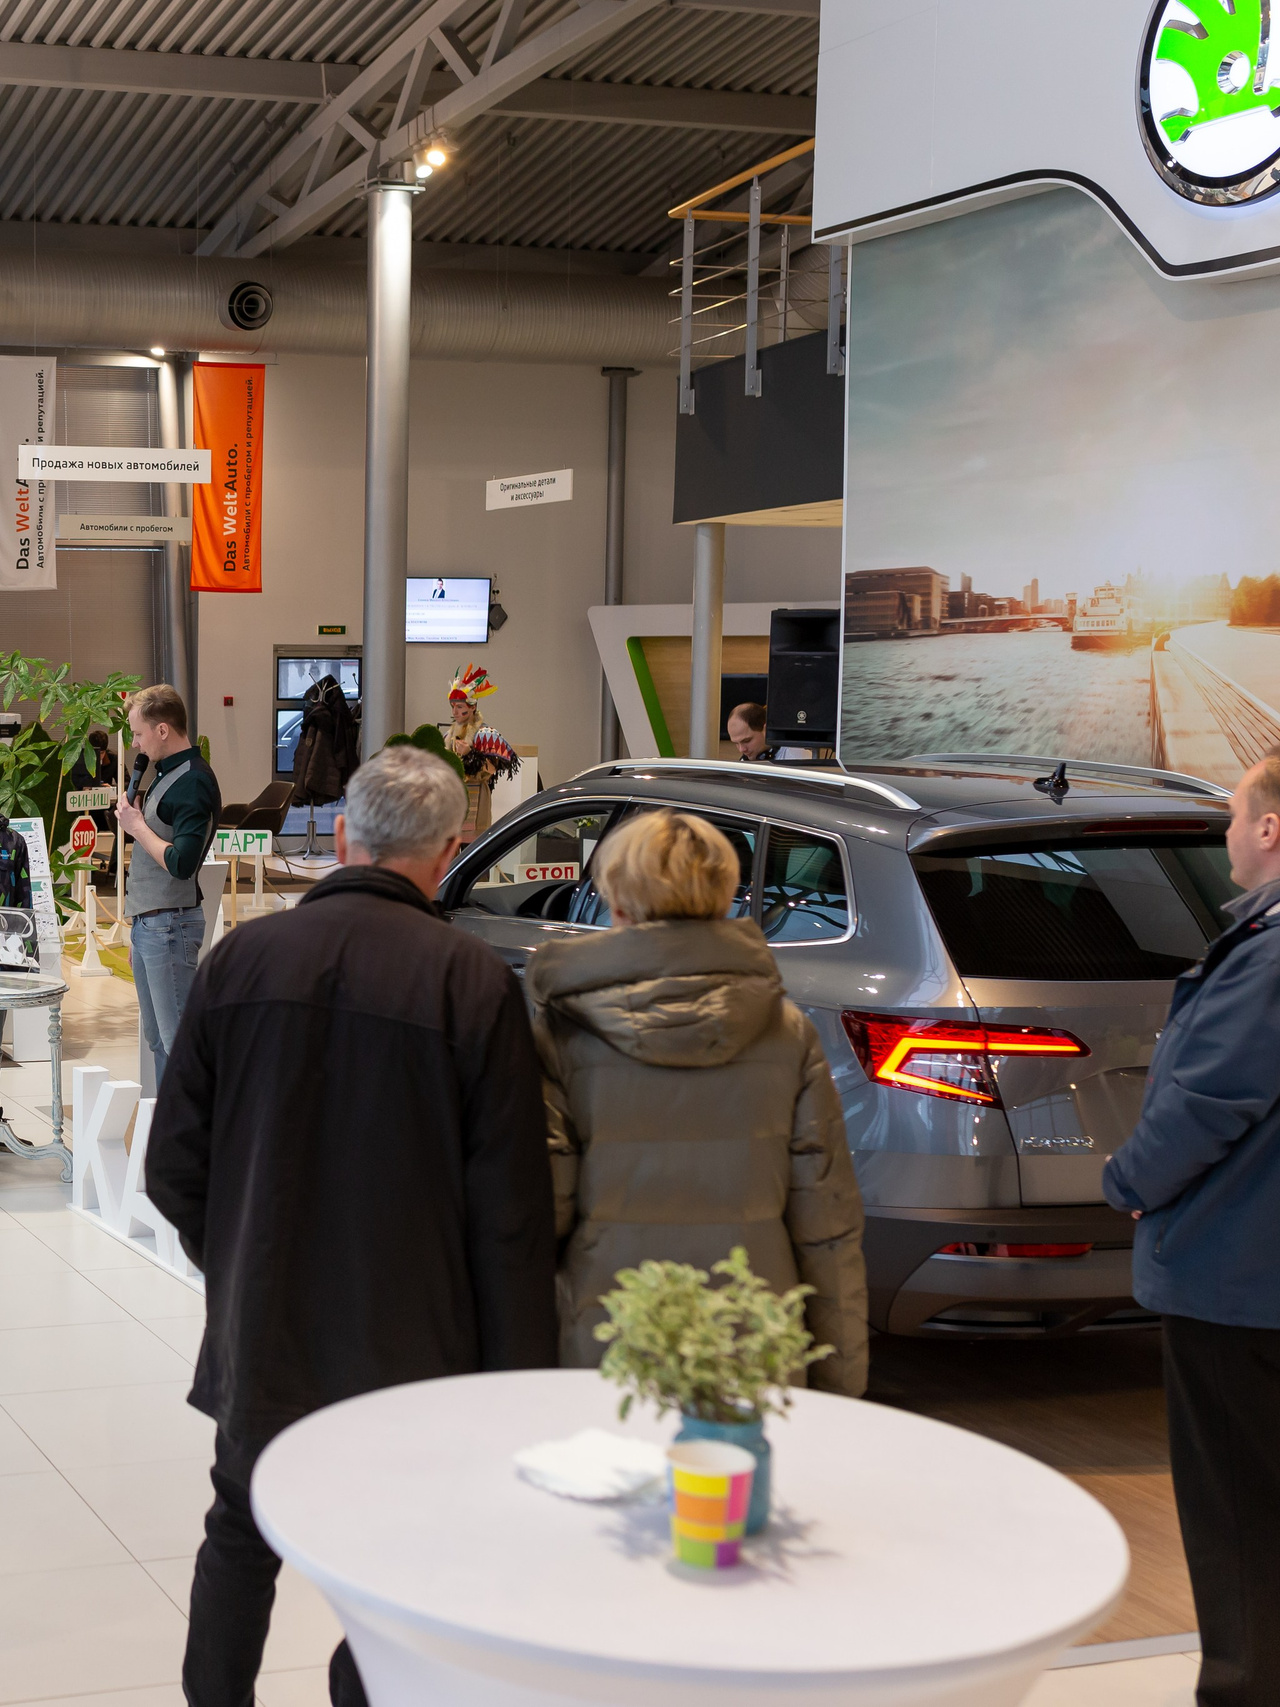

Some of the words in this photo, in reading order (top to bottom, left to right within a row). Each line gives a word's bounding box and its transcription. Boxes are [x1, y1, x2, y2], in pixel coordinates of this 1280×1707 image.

[35, 369, 45, 436] репутацией.
[245, 376, 254, 439] репутацией.
[32, 457, 84, 470] Продажа
[87, 460, 124, 470] новых
[126, 460, 200, 472] автомобилей
[244, 450, 253, 500] пробегом
[15, 438, 30, 533] WeltA.
[223, 443, 238, 536] WeltAuto.
[500, 480, 537, 493] Оригинальные
[537, 477, 556, 487] детали
[515, 490, 544, 502] аксессуары
[36, 505, 45, 569] Автомобили
[80, 523, 128, 532] Автомобили
[135, 525, 173, 533] пробегом
[242, 509, 252, 572] Автомобили
[16, 538, 30, 570] Das
[223, 540, 237, 572] Das
[69, 793, 109, 807] ФИНИШ
[74, 830, 94, 847] STOP
[213, 833, 268, 853] ТАРТ
[526, 866, 574, 880] СТОП
